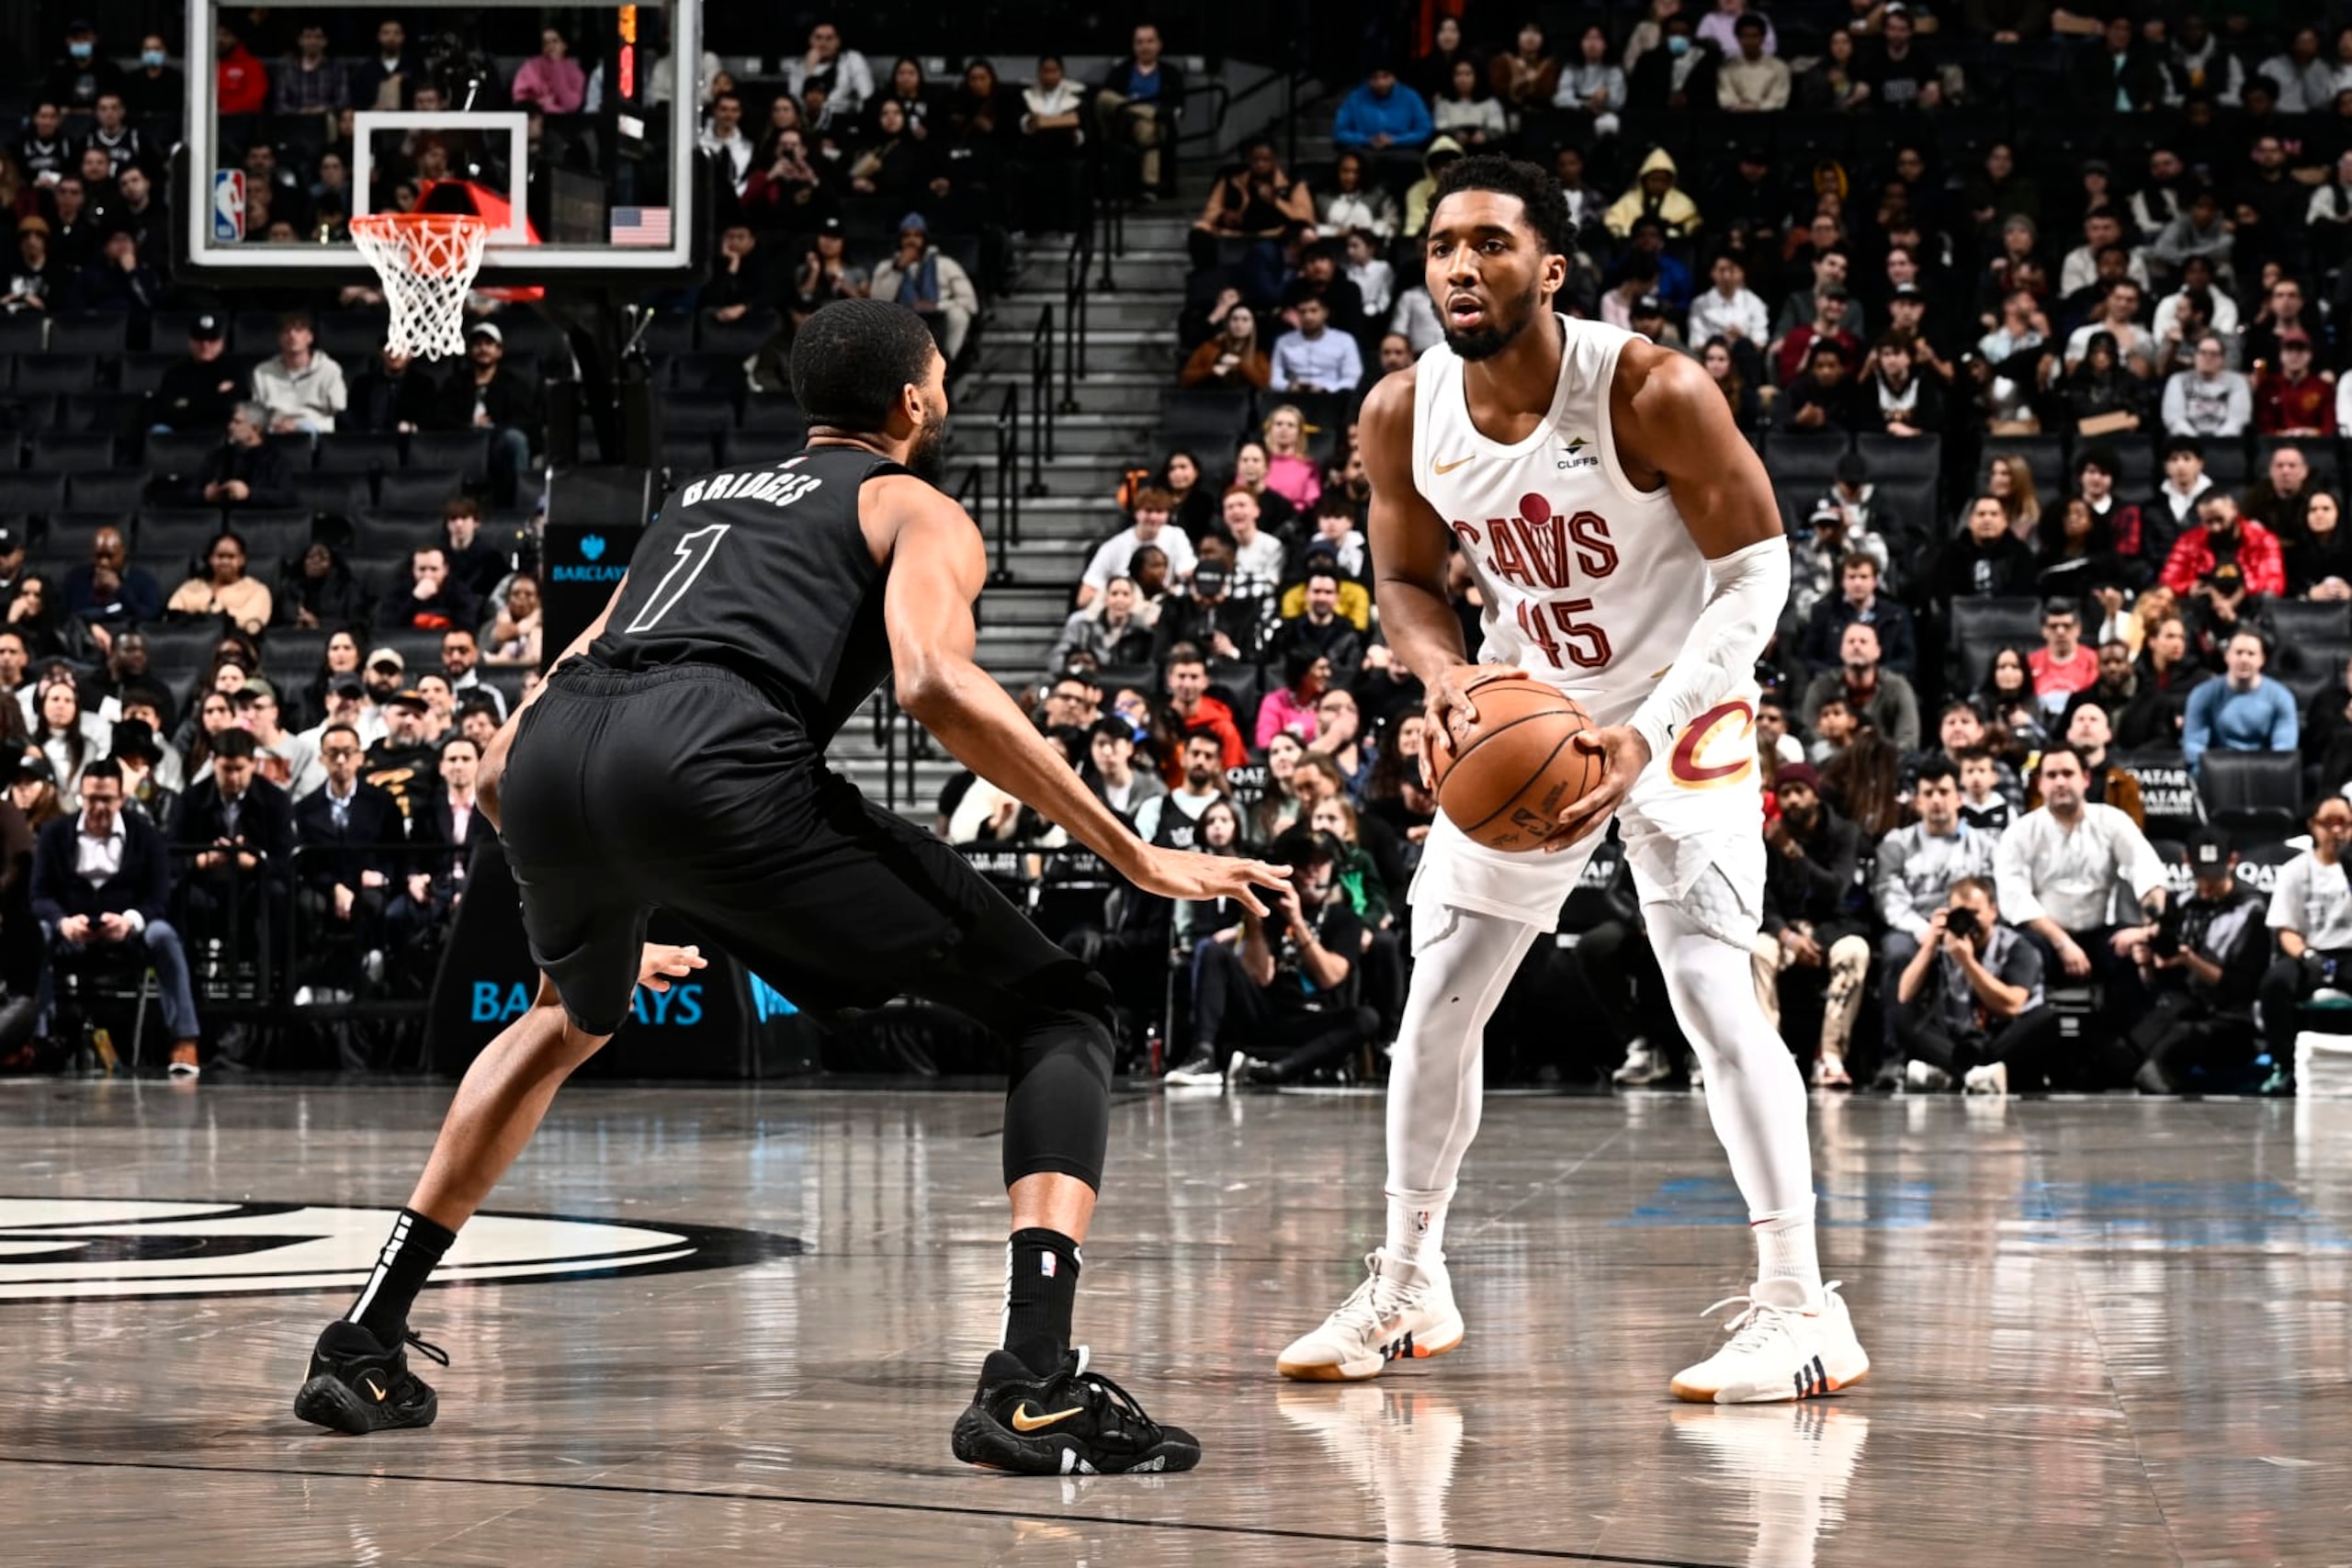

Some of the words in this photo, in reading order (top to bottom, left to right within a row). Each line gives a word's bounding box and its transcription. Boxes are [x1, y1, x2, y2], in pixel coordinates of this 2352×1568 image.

[1557, 456, 1599, 469] CLIFFS
[681, 472, 822, 507] BRIDGES
[553, 565, 629, 581] BARCLAY
[625, 524, 730, 634] 1
[1518, 598, 1611, 670] 45
